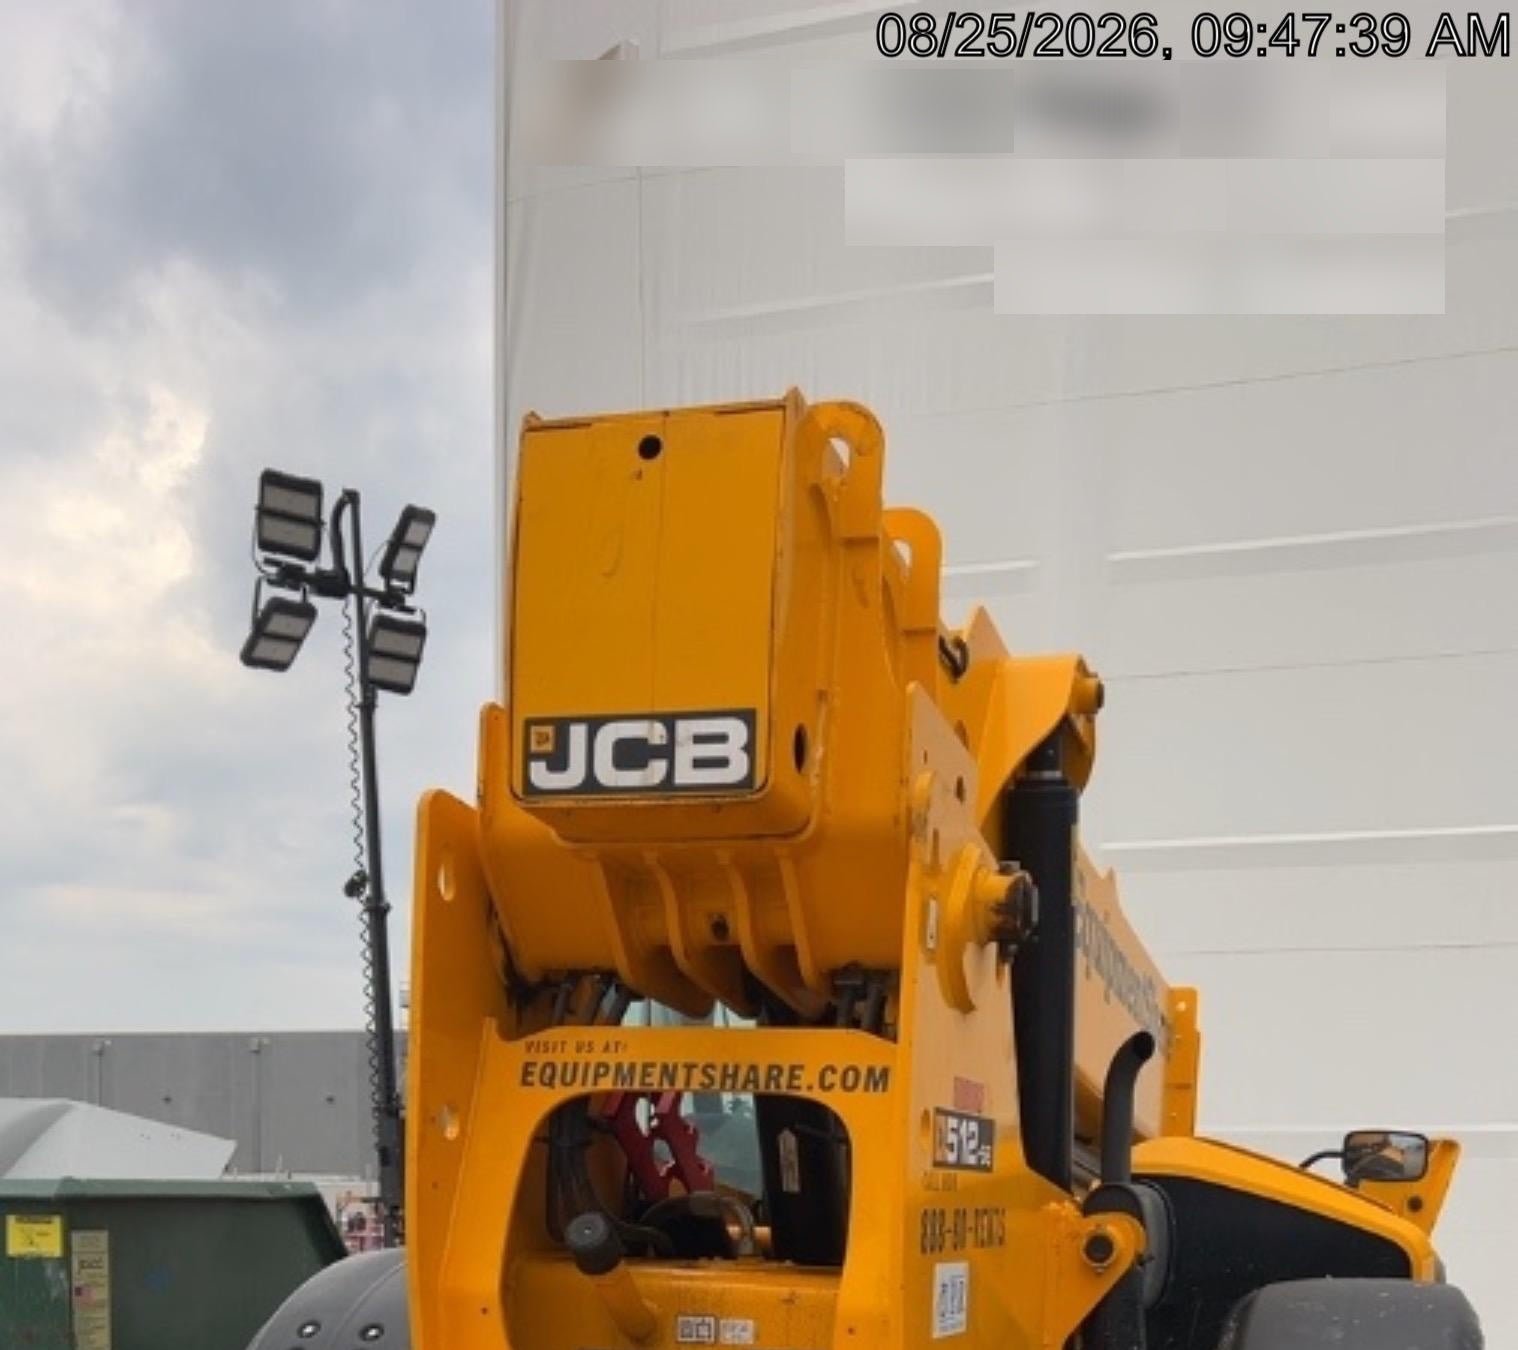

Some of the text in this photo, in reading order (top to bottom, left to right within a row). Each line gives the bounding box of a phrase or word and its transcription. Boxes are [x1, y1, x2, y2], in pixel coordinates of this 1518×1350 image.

[529, 717, 749, 790] JCB
[524, 1040, 568, 1054] VISIT
[575, 1040, 594, 1054] US
[520, 1060, 891, 1093] EQUIPMENTSHARE.COM
